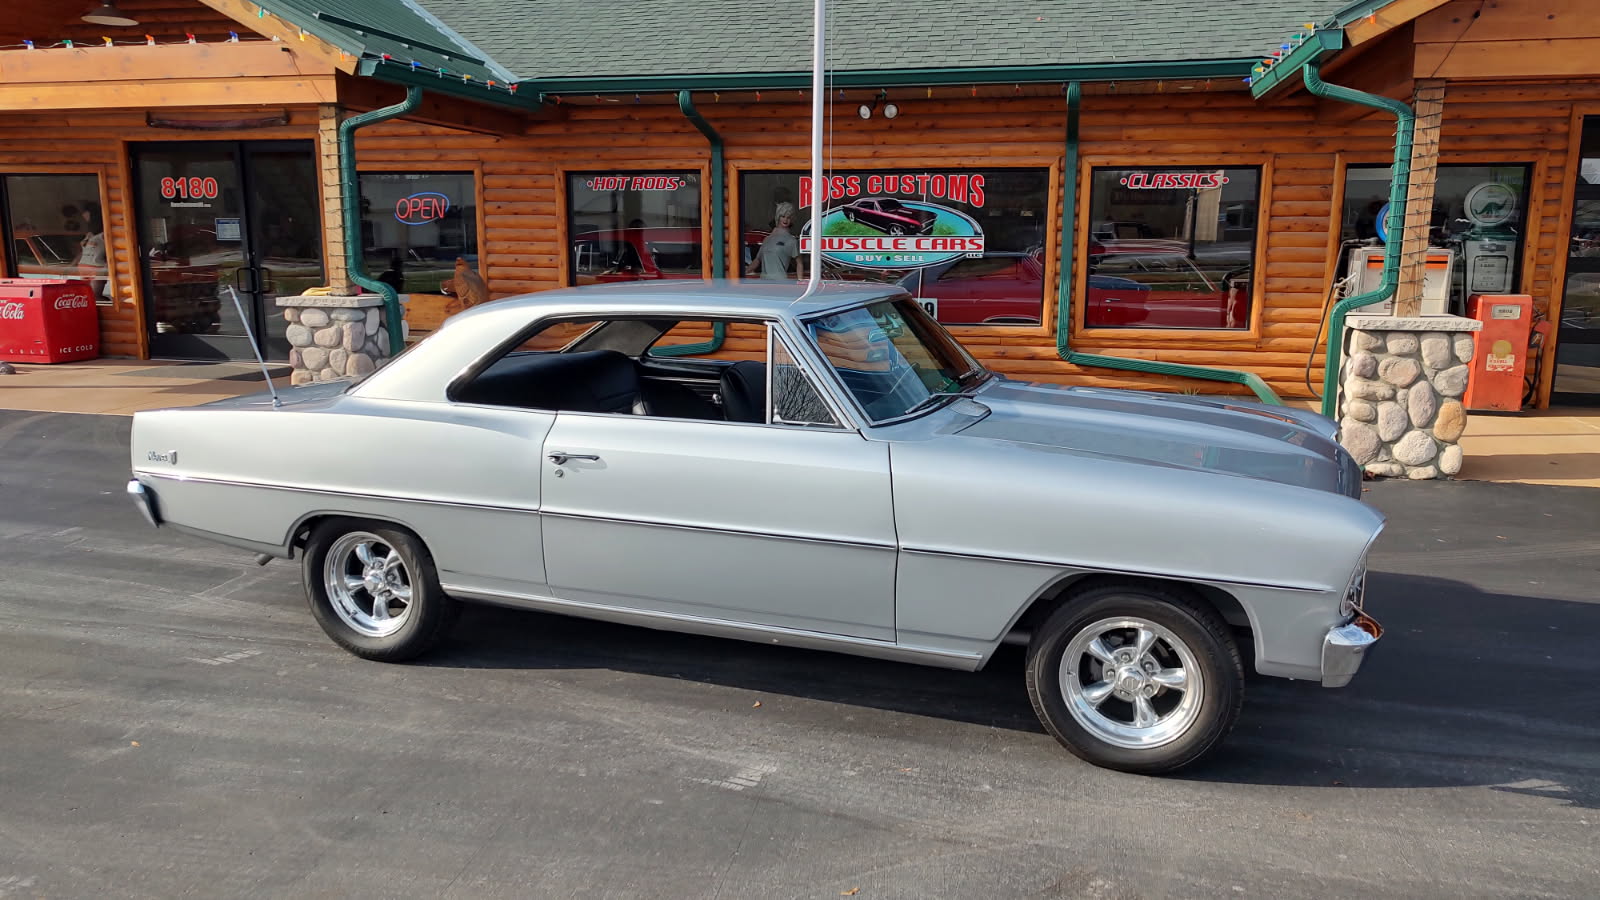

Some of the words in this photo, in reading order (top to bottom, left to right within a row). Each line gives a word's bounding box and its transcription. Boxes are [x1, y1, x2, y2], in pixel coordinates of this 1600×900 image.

[161, 177, 218, 199] 8180
[593, 176, 630, 191] HOT
[631, 176, 680, 191] RODS
[1127, 173, 1222, 189] CLASSICS
[868, 175, 984, 207] CUSTOMS
[396, 197, 445, 219] OPEN
[801, 238, 906, 250] MUSCLE
[915, 238, 983, 250] CARS
[75, 344, 93, 352] COLD
